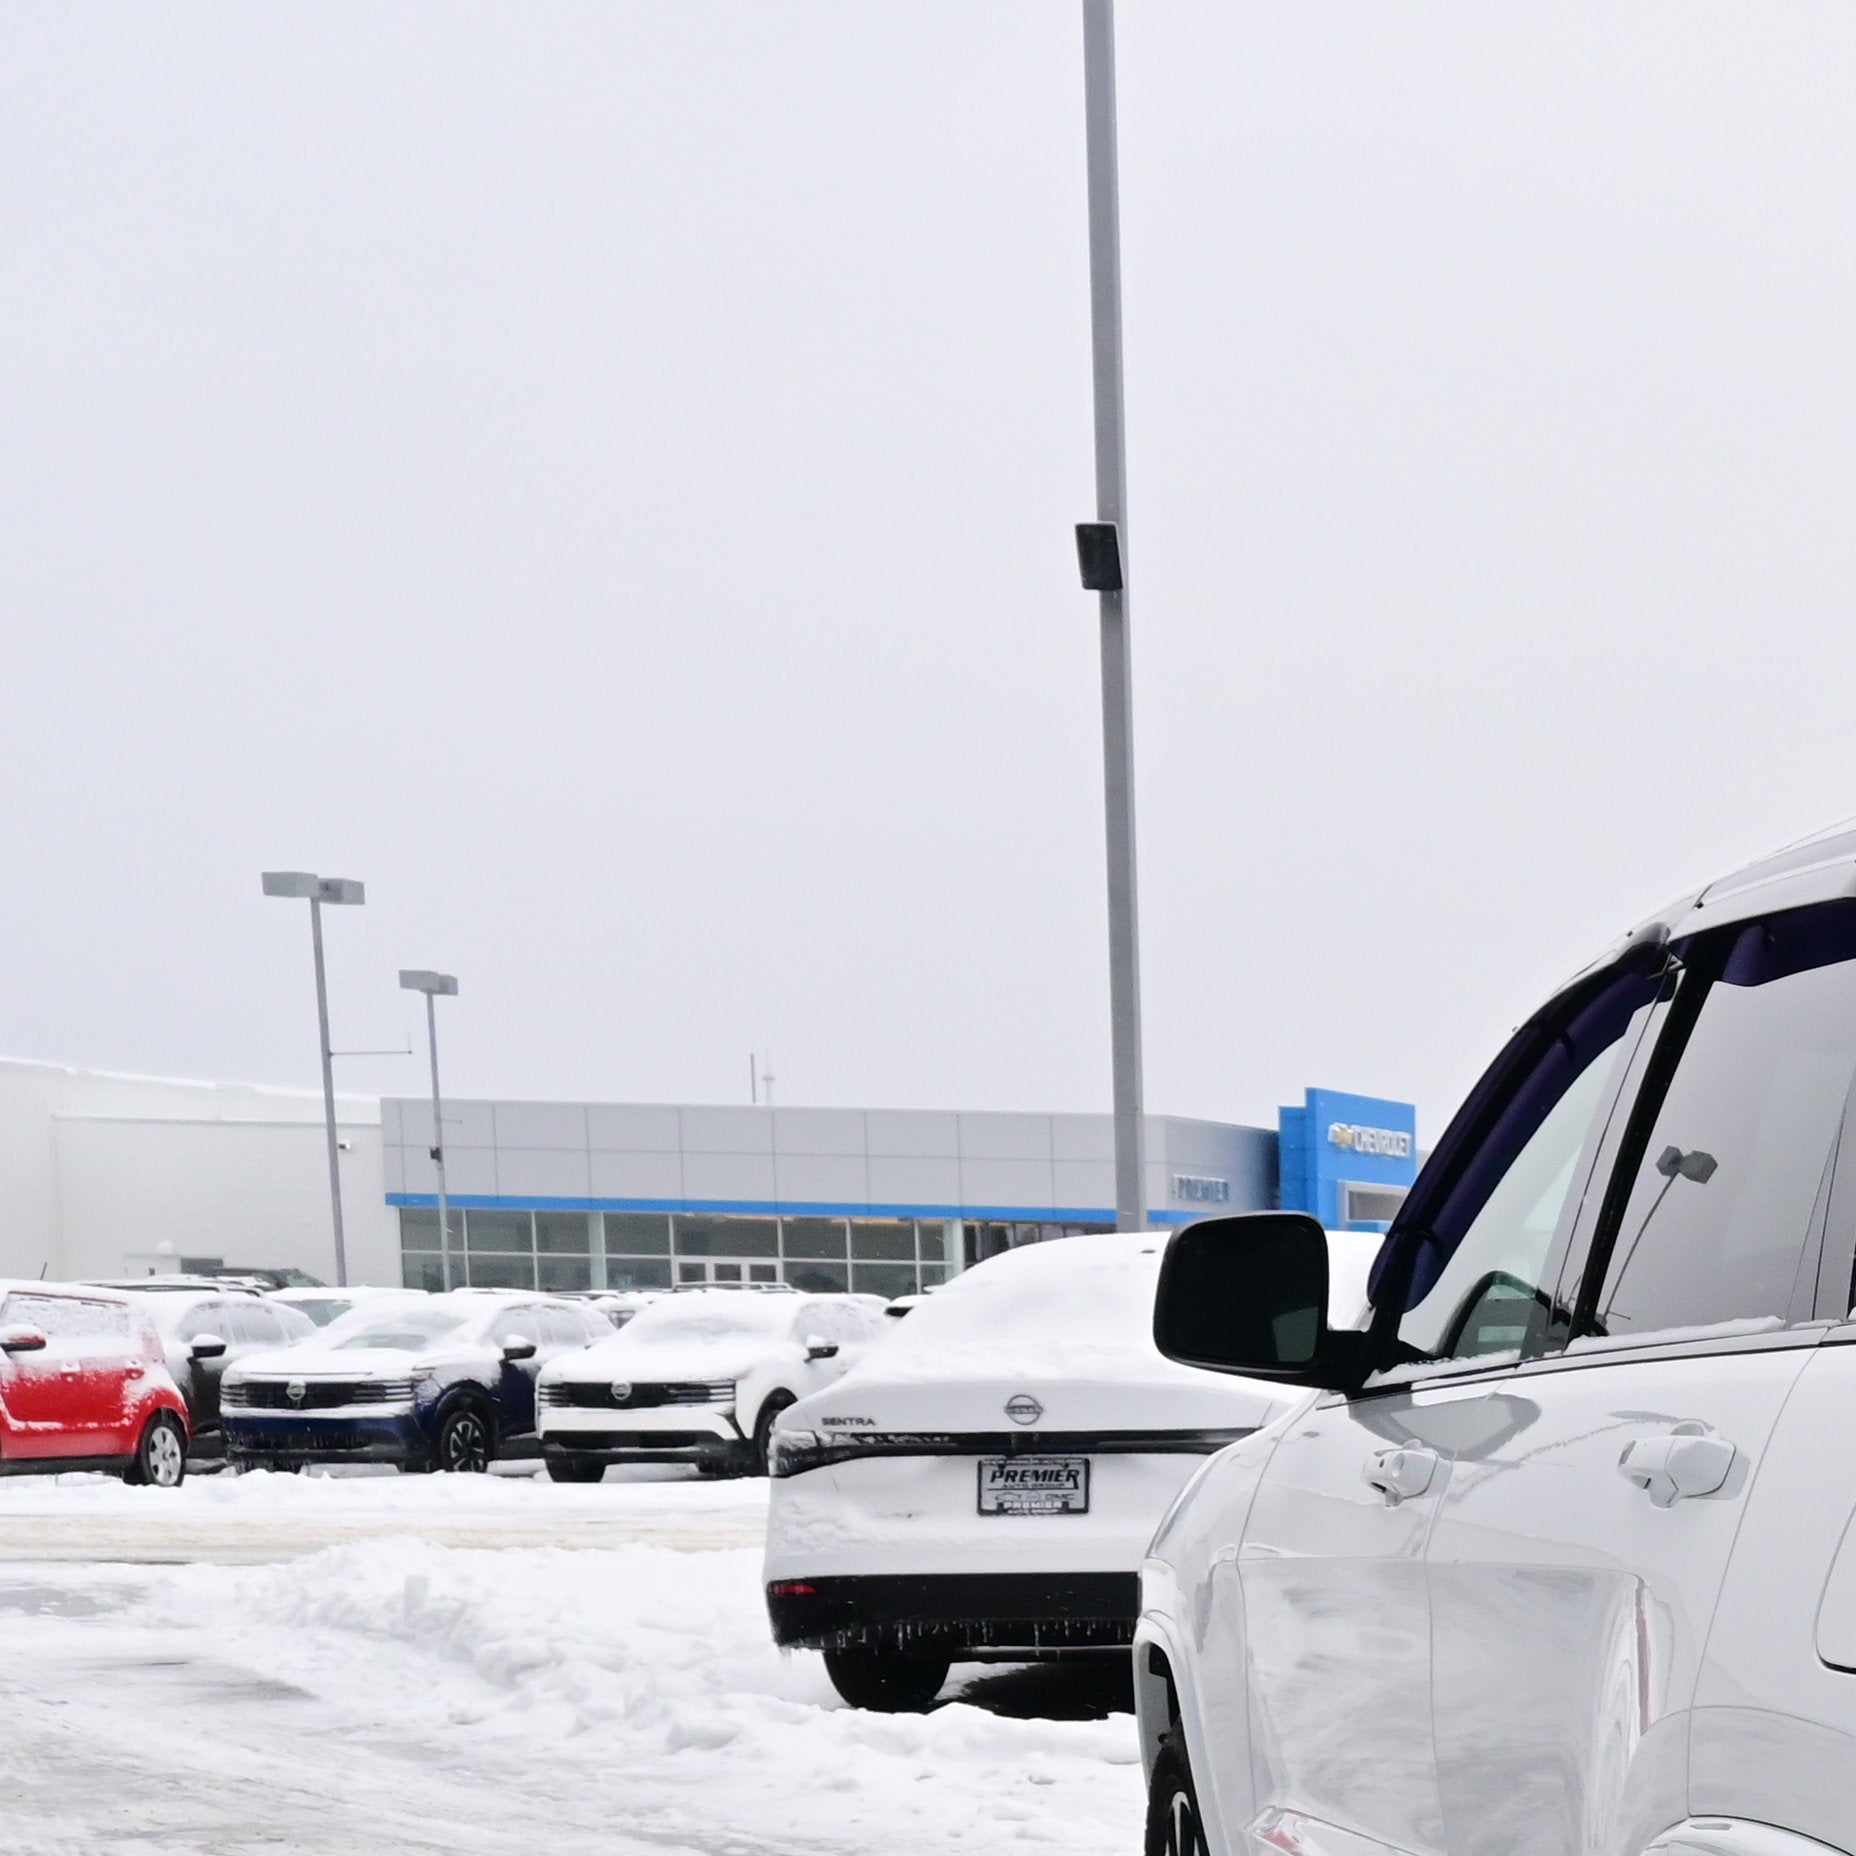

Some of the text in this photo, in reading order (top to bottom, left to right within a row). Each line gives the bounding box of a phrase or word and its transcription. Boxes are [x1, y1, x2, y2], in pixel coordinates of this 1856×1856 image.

[1352, 1124, 1411, 1158] CHEVROLET
[821, 1417, 876, 1426] SENTRA
[989, 1469, 1080, 1483] PREMIER
